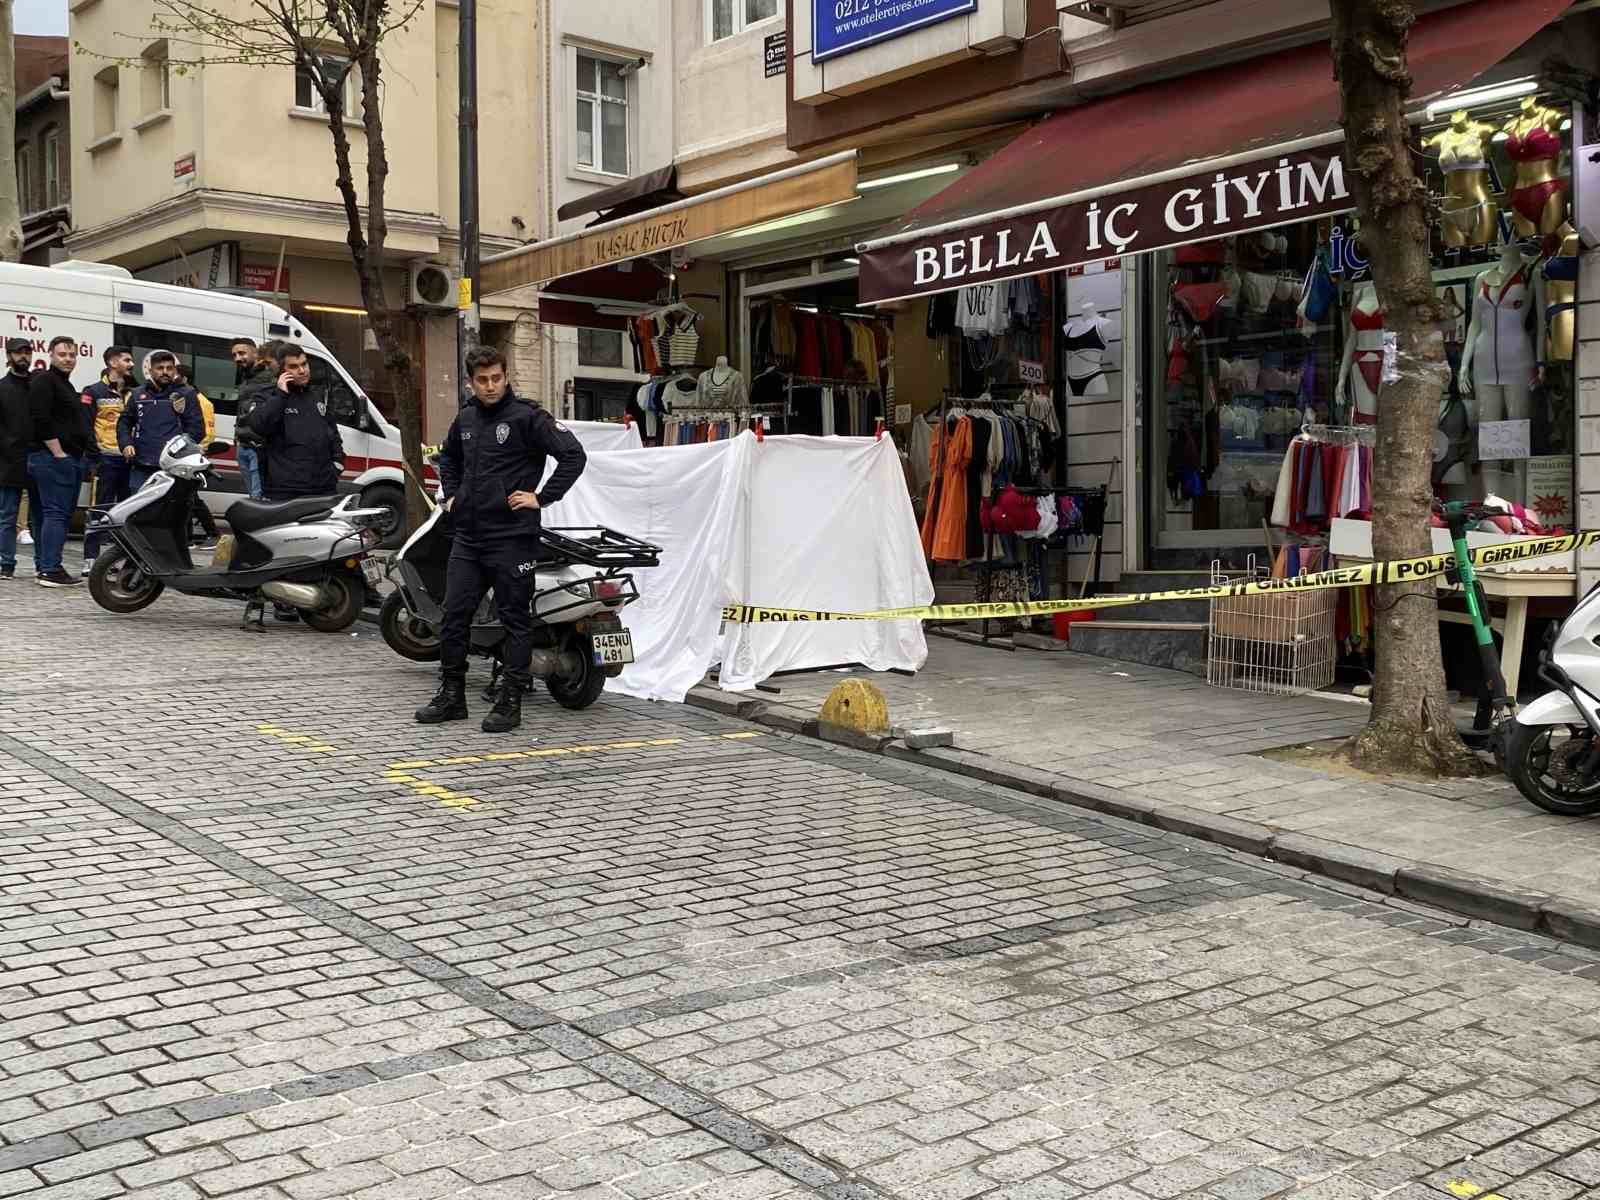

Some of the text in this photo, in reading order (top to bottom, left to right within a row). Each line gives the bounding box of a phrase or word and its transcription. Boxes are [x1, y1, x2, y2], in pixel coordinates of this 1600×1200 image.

[913, 220, 1060, 285] BELLA
[1086, 202, 1139, 254] İÇ
[1164, 154, 1349, 233] GİYİM
[16, 314, 42, 333] T.C.
[1022, 366, 1042, 379] 200
[604, 648, 623, 661] 481
